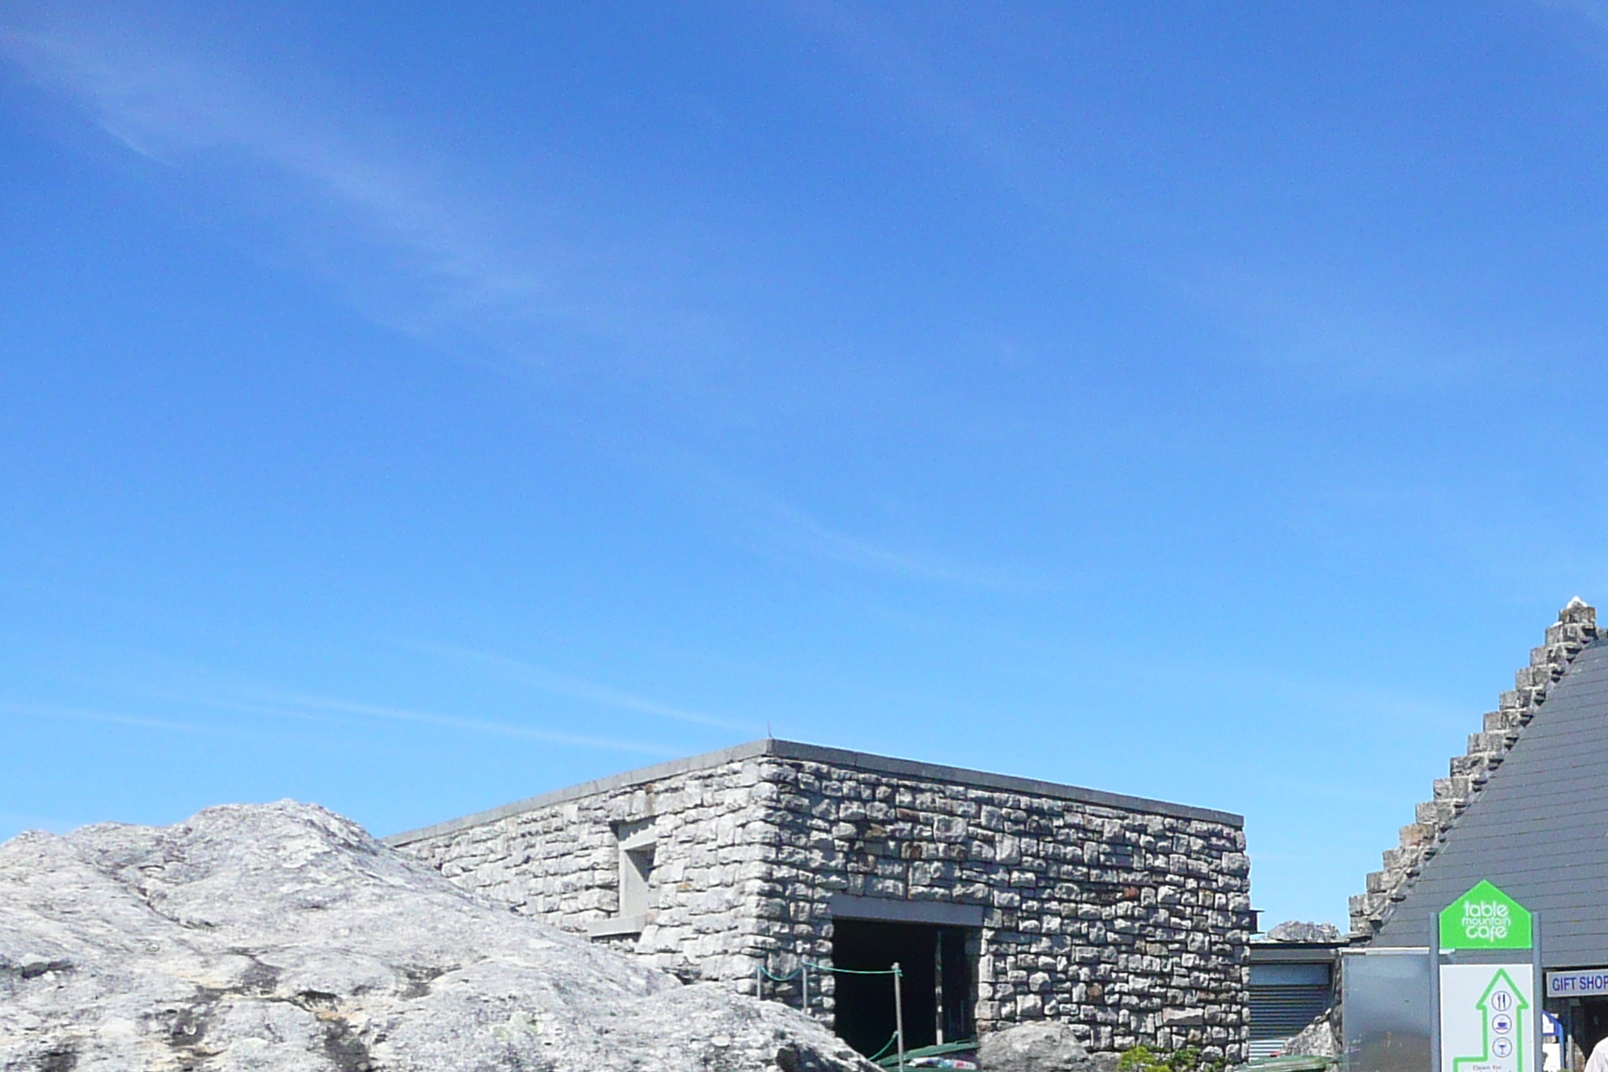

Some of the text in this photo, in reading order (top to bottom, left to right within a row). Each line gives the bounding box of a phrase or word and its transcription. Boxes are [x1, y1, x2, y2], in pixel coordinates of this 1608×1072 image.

[1463, 900, 1509, 917] table
[1461, 916, 1511, 927] mountain
[1465, 925, 1508, 943] cafe
[1552, 976, 1577, 992] GIFT
